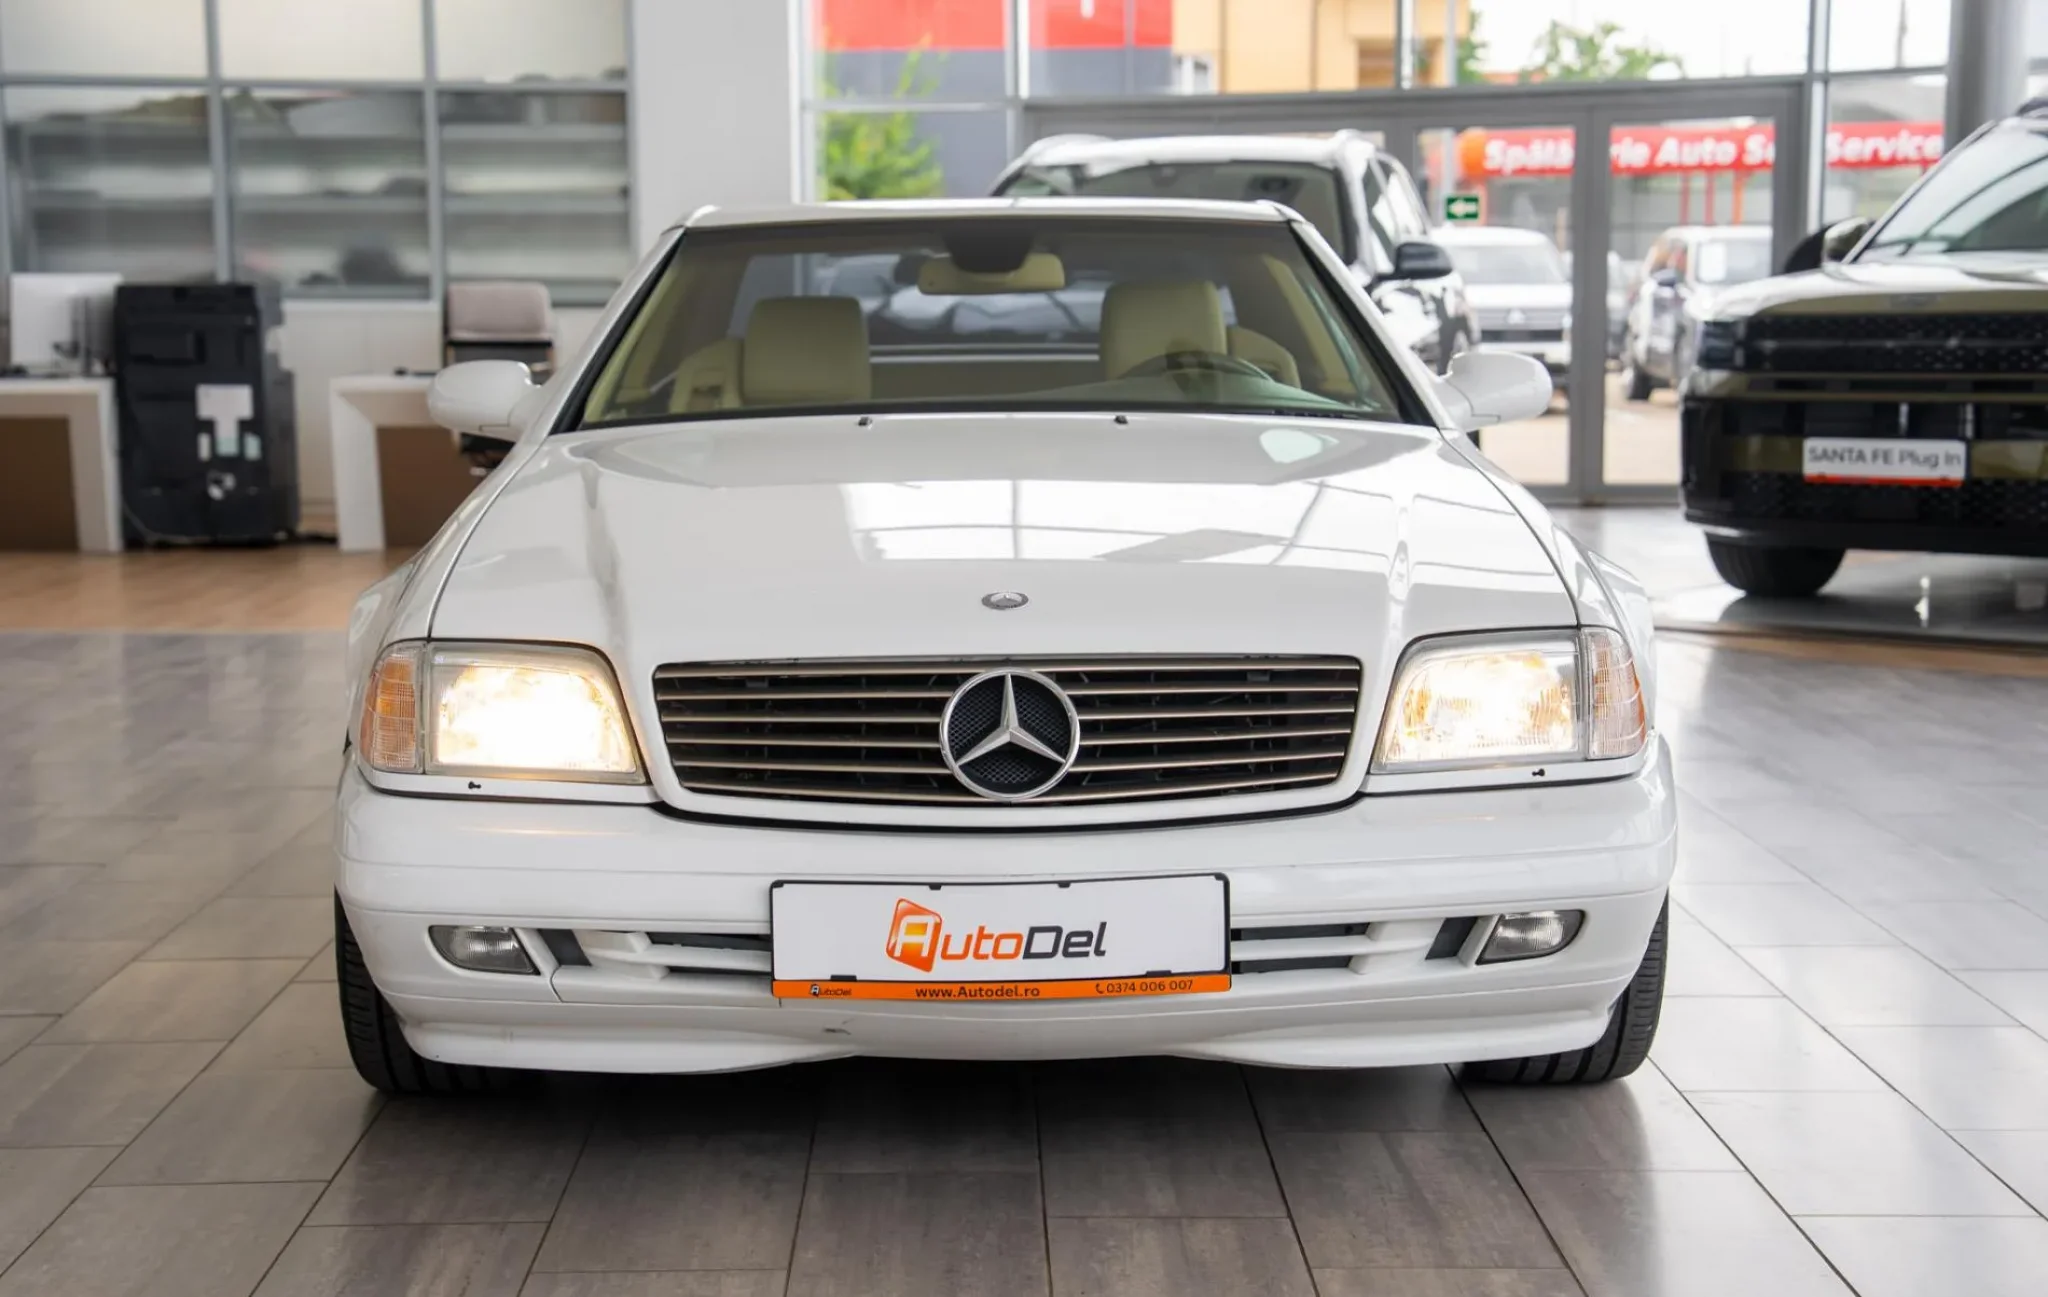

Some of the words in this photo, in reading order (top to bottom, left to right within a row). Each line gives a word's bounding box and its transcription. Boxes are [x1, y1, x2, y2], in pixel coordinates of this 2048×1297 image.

[1653, 136, 1737, 167] Auto
[1826, 129, 1945, 164] Service
[1808, 446, 1867, 465] SANTA
[1872, 448, 1895, 466] FE
[1899, 449, 1940, 469] Plug
[1945, 452, 1962, 467] In
[889, 908, 1107, 963] AutoDel
[809, 983, 852, 997] AutoDel
[914, 984, 1041, 999] www.Autodel.ro
[1106, 982, 1137, 994] 0374
[1140, 981, 1166, 993] 006
[1169, 979, 1194, 991] 007
